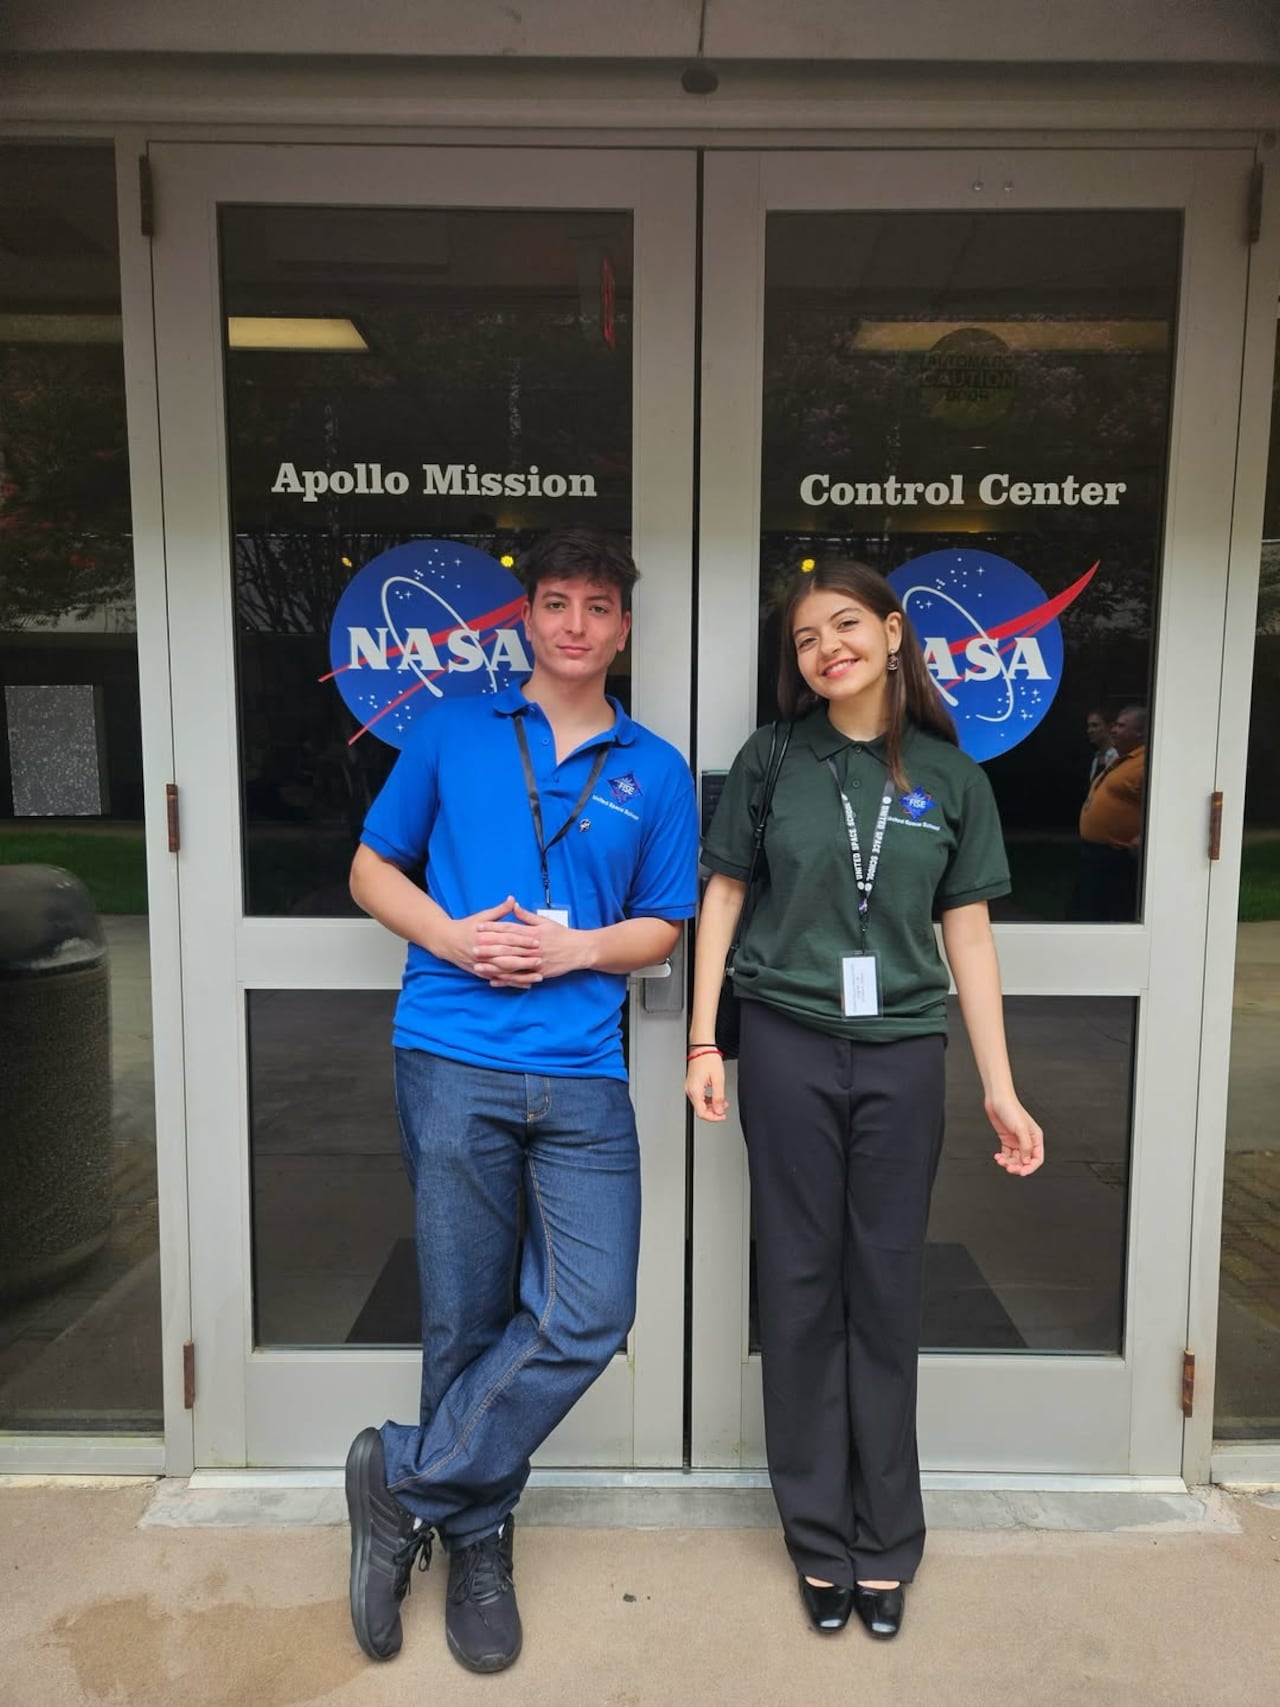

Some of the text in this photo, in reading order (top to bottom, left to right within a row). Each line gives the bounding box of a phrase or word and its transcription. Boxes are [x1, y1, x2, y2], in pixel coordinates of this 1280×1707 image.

[921, 369, 1017, 387] CAUTION
[271, 462, 597, 502] Apollo Mission
[800, 474, 1127, 505] Control Center
[347, 627, 534, 672] NASA
[923, 637, 1052, 682] ASA
[848, 828, 860, 851] SPACE
[866, 805, 890, 881] UNITED SPACE SCHOOL
[853, 852, 863, 881] UNITED
